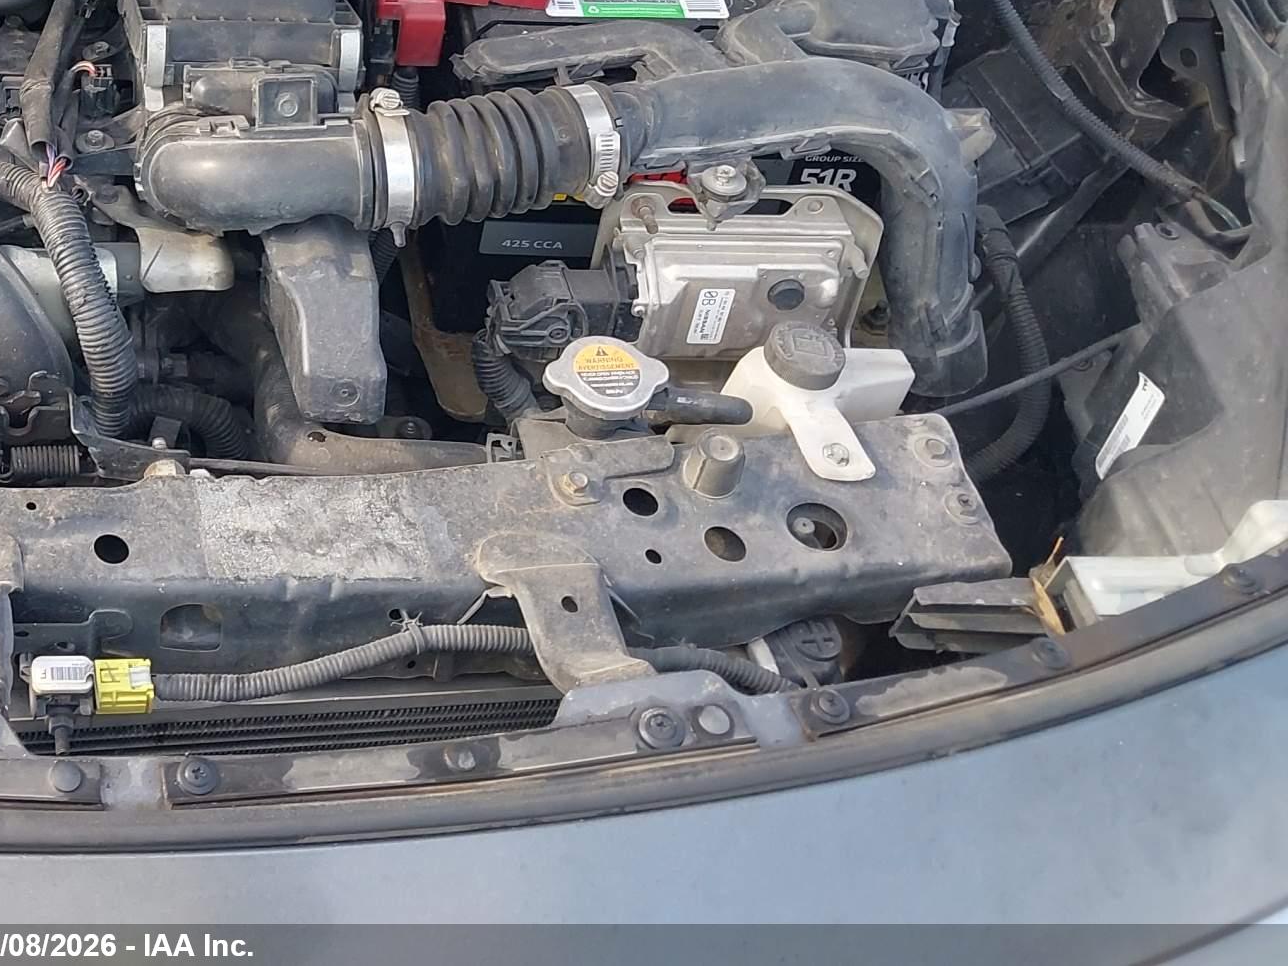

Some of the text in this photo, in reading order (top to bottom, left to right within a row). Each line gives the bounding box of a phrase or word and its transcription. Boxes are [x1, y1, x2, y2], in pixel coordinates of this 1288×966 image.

[800, 168, 857, 192] 51R
[502, 239, 562, 249] 425 CCA
[699, 309, 711, 334] NISSAN
[585, 356, 623, 364] WARNING
[578, 362, 635, 371] AVERTISSEMENT
